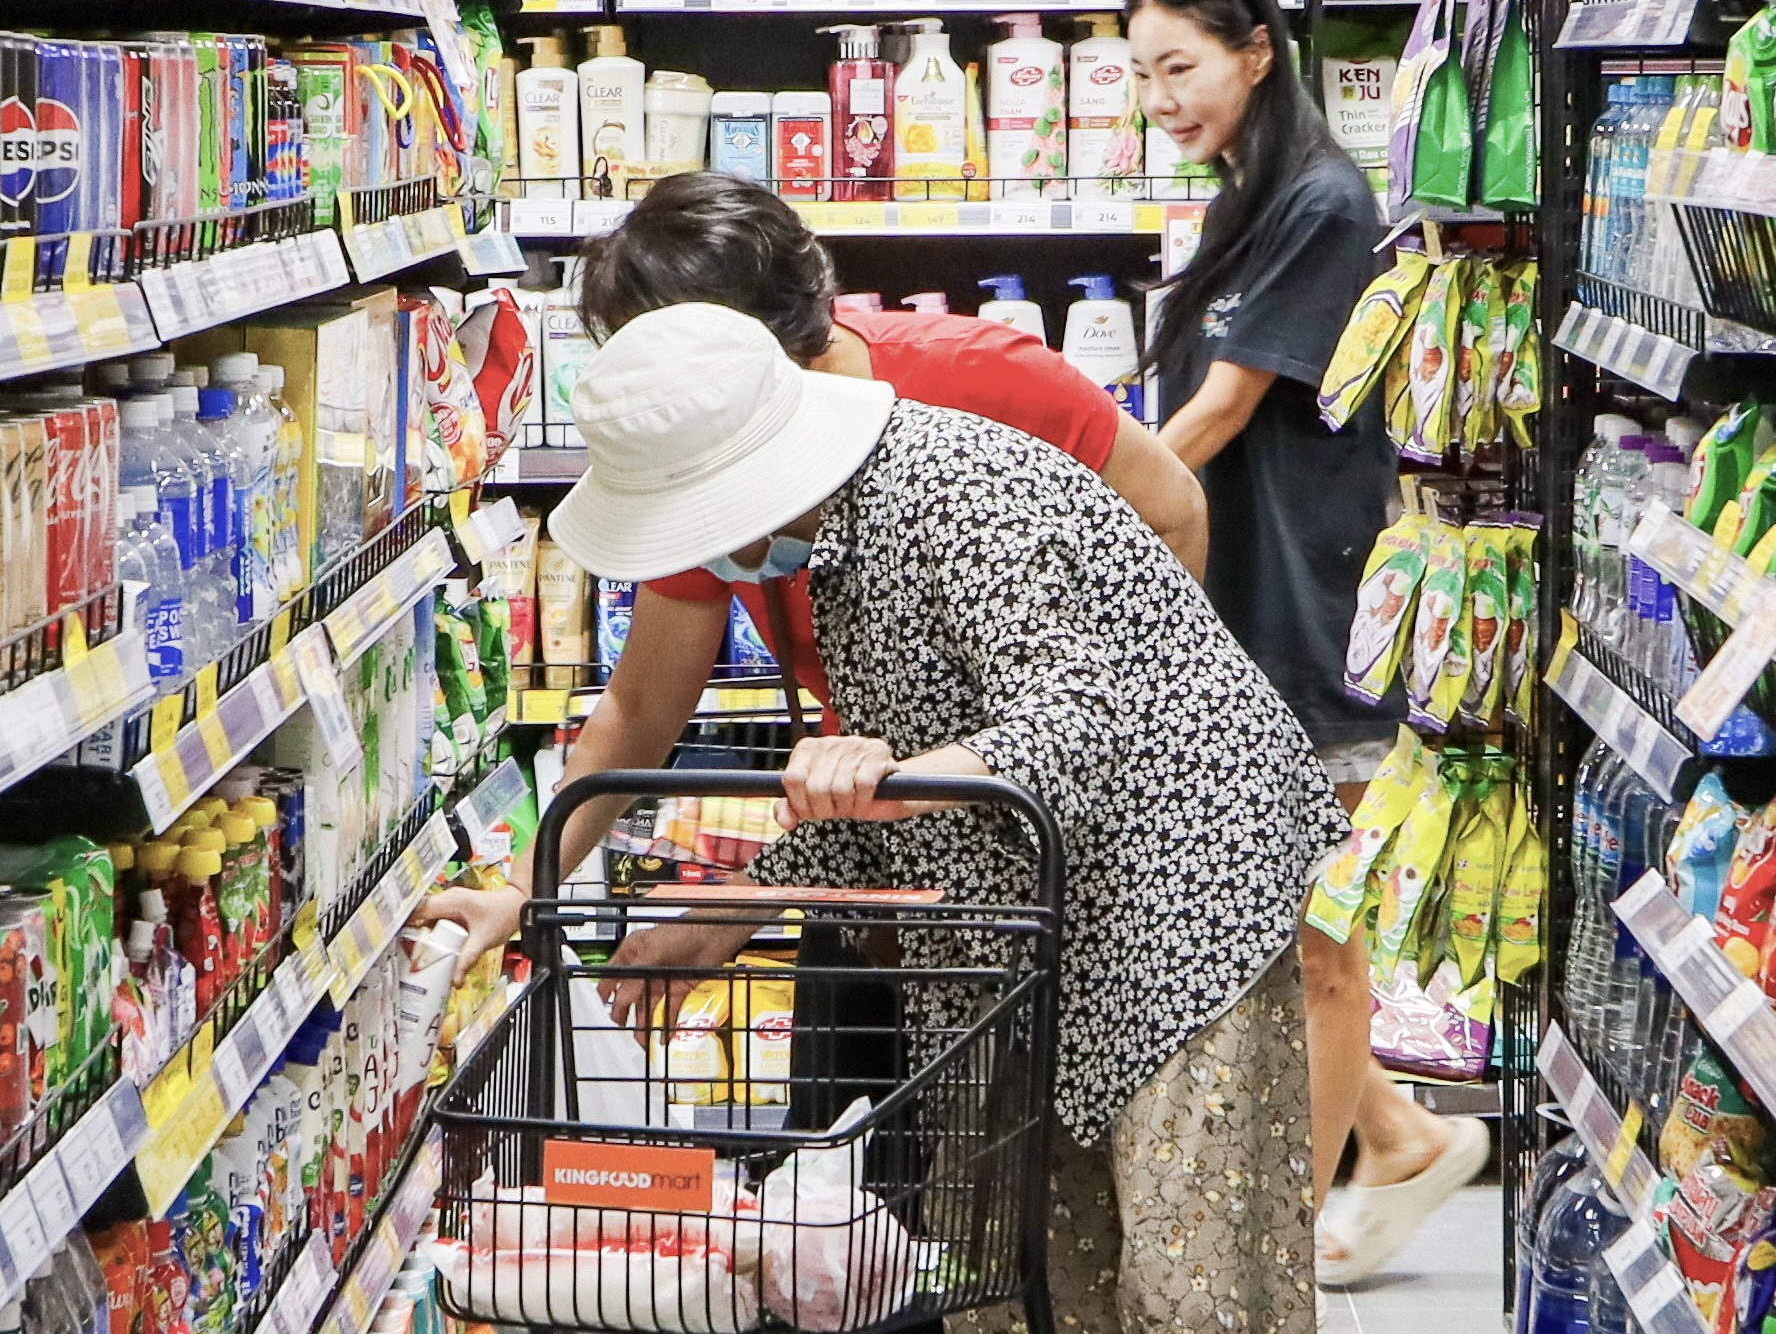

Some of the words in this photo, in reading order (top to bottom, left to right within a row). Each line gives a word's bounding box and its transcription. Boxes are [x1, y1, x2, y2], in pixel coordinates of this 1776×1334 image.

[1338, 68, 1380, 83] KEN
[525, 91, 560, 104] CLEAR
[586, 85, 622, 98] CLEAR
[1359, 84, 1380, 100] JU
[1338, 109, 1366, 122] Thin
[1017, 215, 1035, 223] 214
[1099, 213, 1117, 221] 214
[1082, 325, 1117, 340] Dove
[489, 558, 531, 570] PANTENE
[538, 573, 577, 585] PANTENE
[553, 1167, 703, 1191] KINGFOODmart
